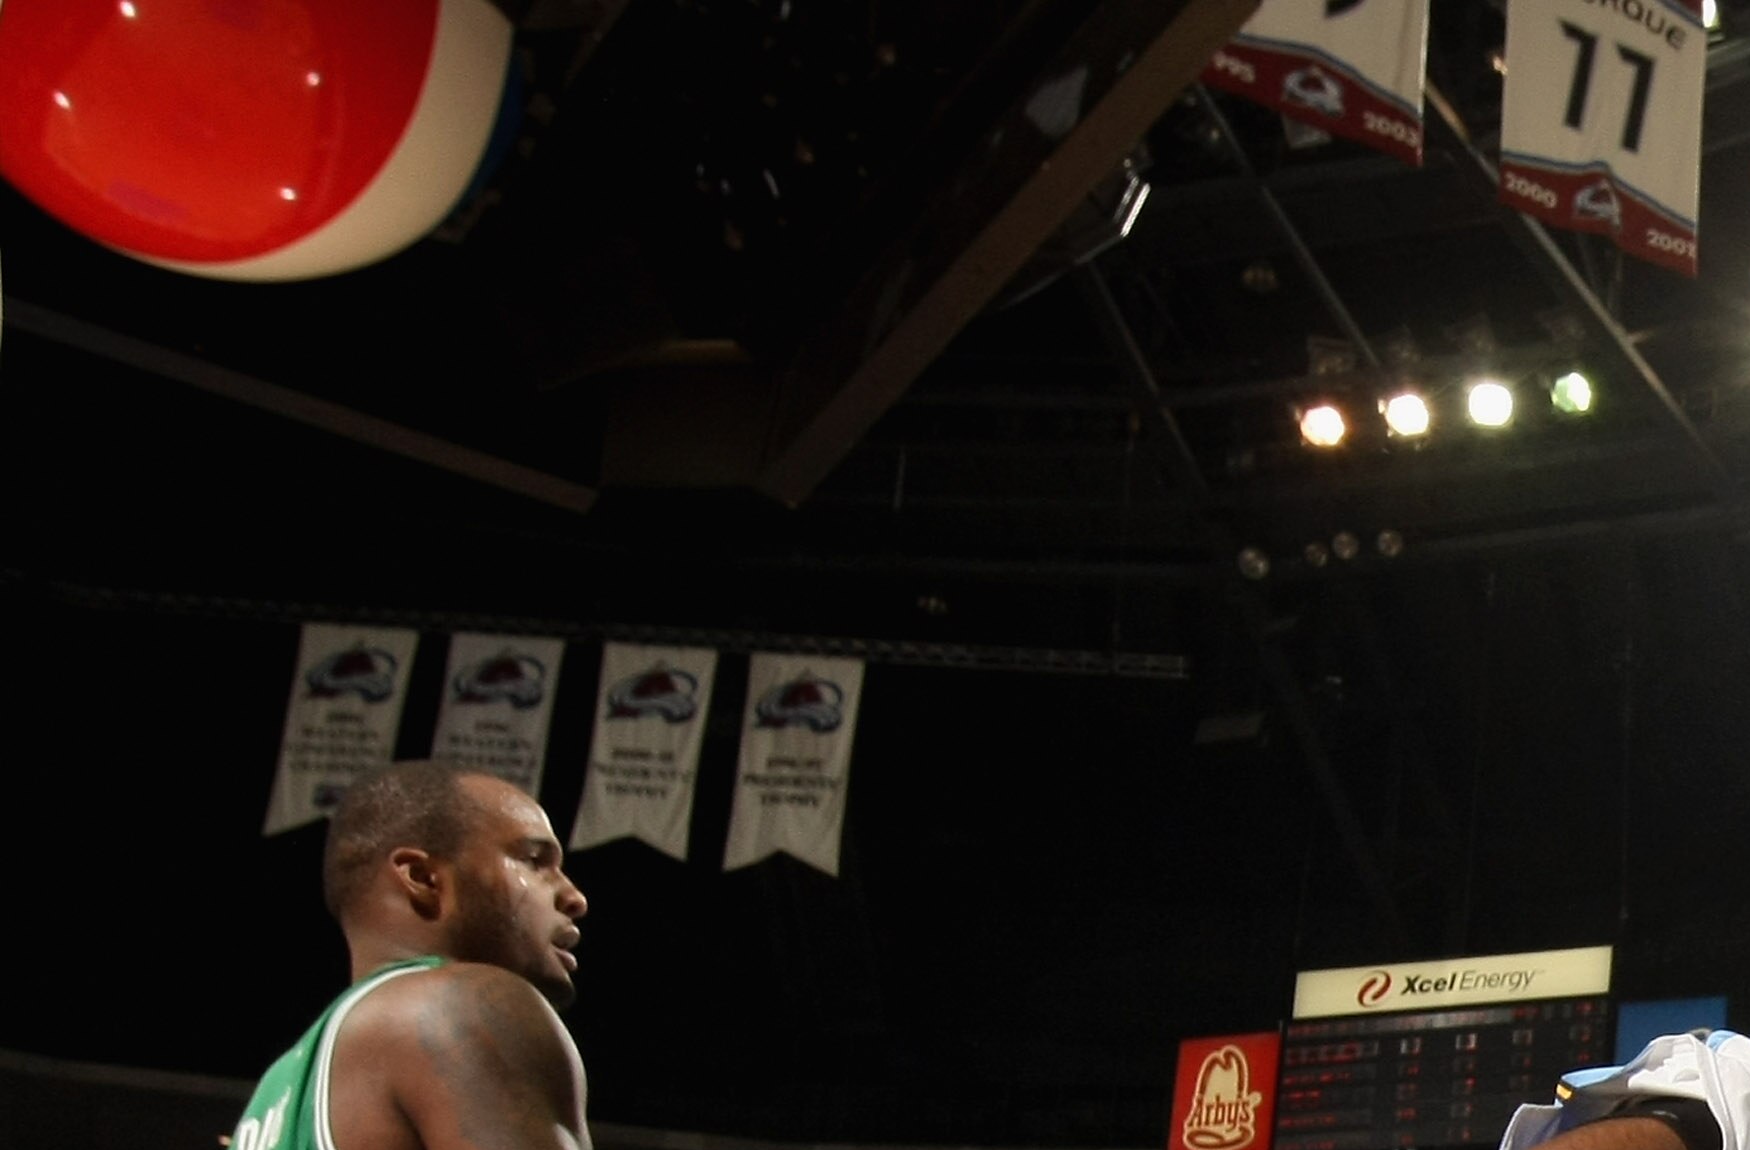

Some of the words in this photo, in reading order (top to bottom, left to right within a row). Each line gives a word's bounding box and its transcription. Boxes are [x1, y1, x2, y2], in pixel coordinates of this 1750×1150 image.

[1212, 52, 1257, 84] 995
[1559, 19, 1657, 154] 11
[1504, 171, 1558, 209] 2000
[1400, 972, 1457, 995] Xcel
[1459, 969, 1536, 993] Energy
